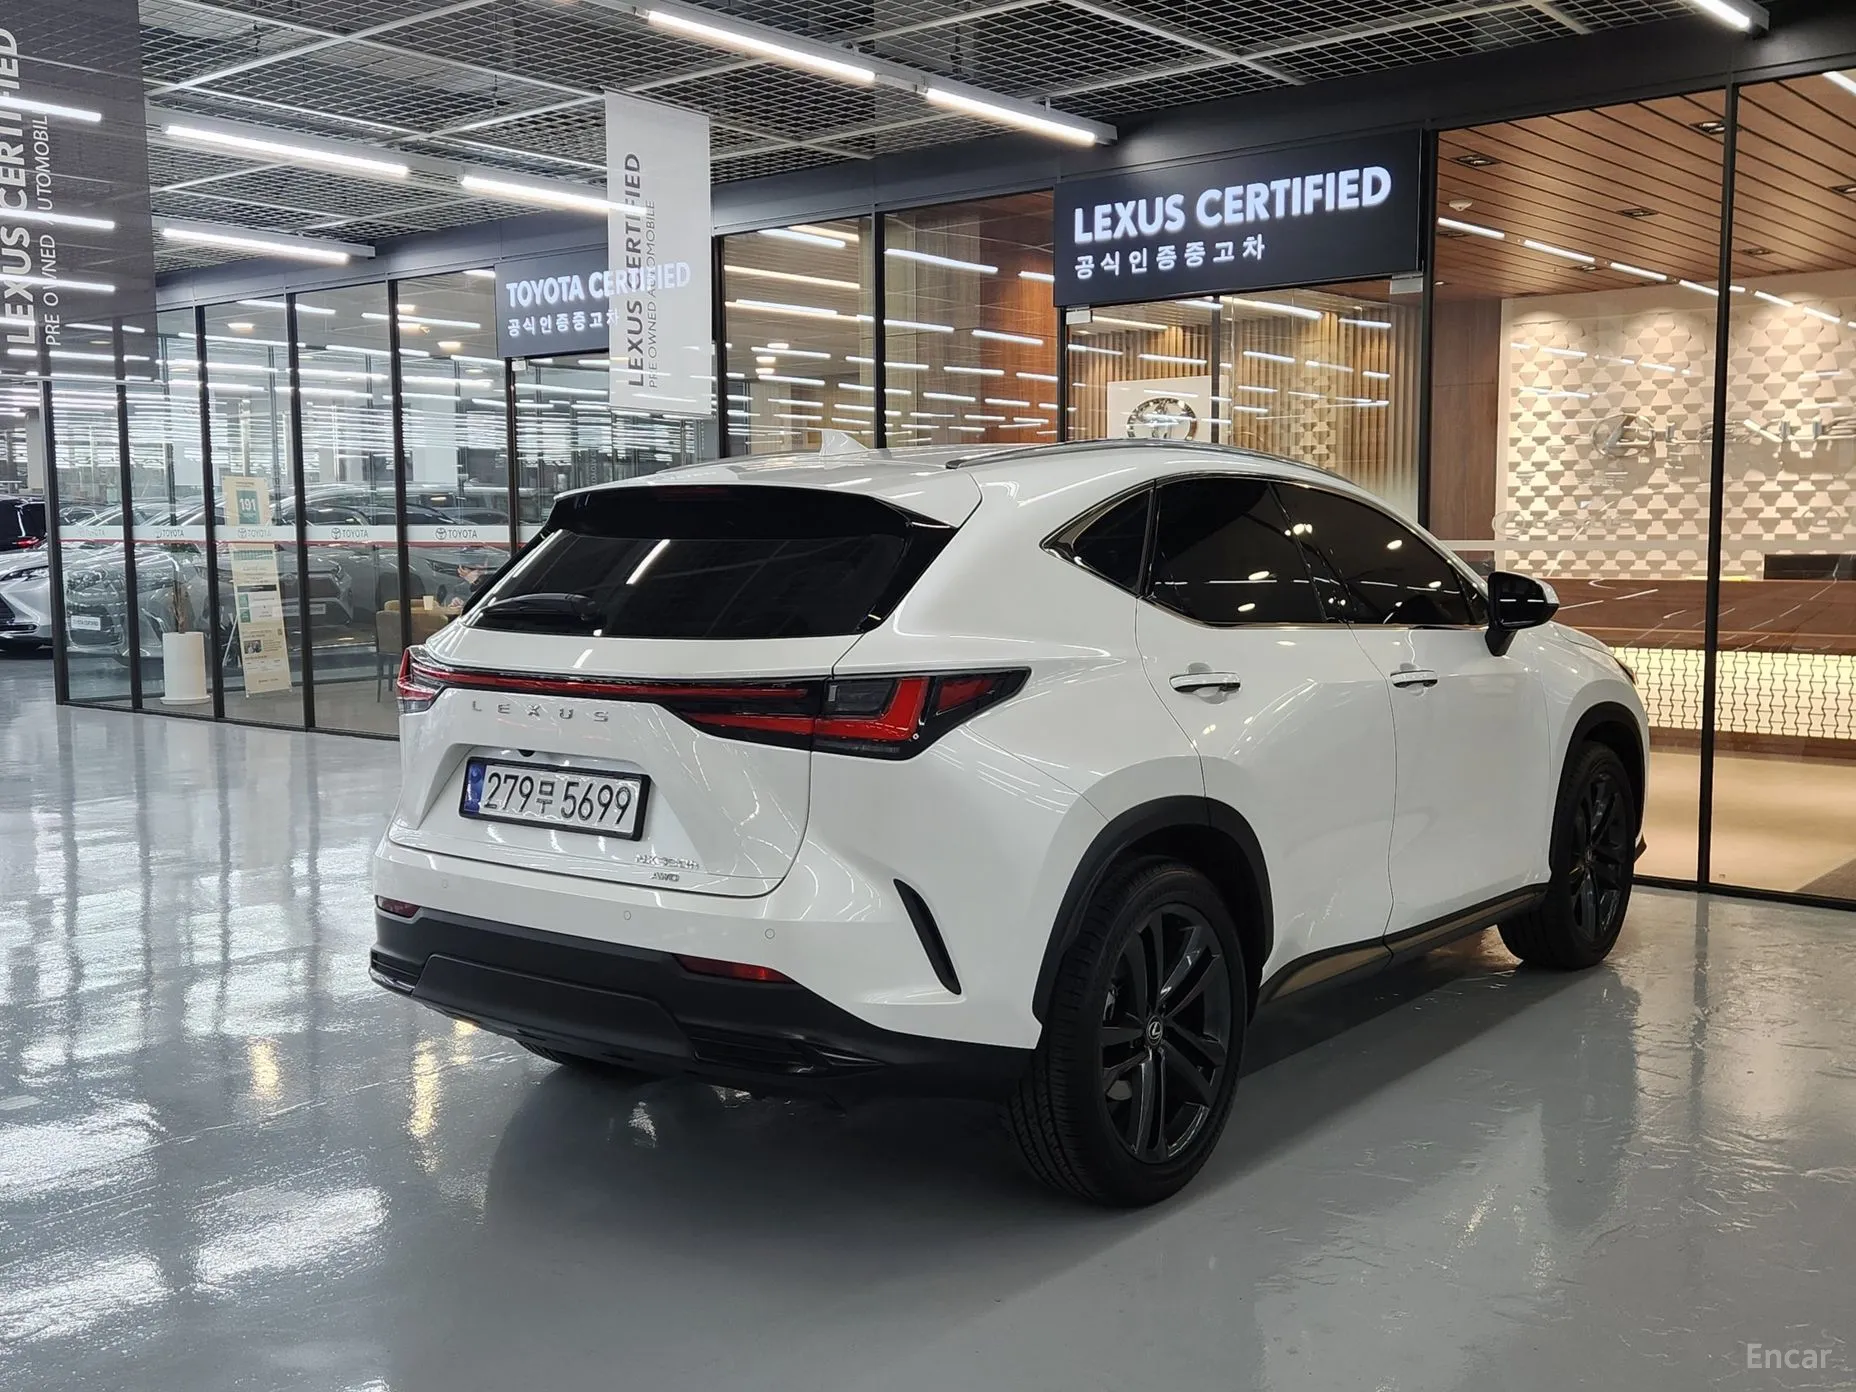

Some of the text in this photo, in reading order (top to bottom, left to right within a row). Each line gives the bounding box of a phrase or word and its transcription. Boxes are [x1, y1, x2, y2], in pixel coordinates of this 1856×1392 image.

[1073, 166, 1393, 244] LEXUS CERTIFIED
[1074, 233, 1265, 280] 공식인증중고차
[0, 226, 36, 344] LEXUS
[505, 274, 586, 308] TOYOTA
[44, 314, 61, 345] PRE
[507, 308, 620, 337] 공식인증중고차
[648, 301, 657, 359] OWNED
[626, 300, 644, 387] LEXUS
[162, 529, 185, 538] TOYOTA
[247, 529, 272, 538] TOYOTA
[342, 529, 369, 538] TOYOTA
[448, 529, 478, 538] TOYOTA
[472, 700, 609, 722] LEXUS
[650, 872, 680, 882] AWD
